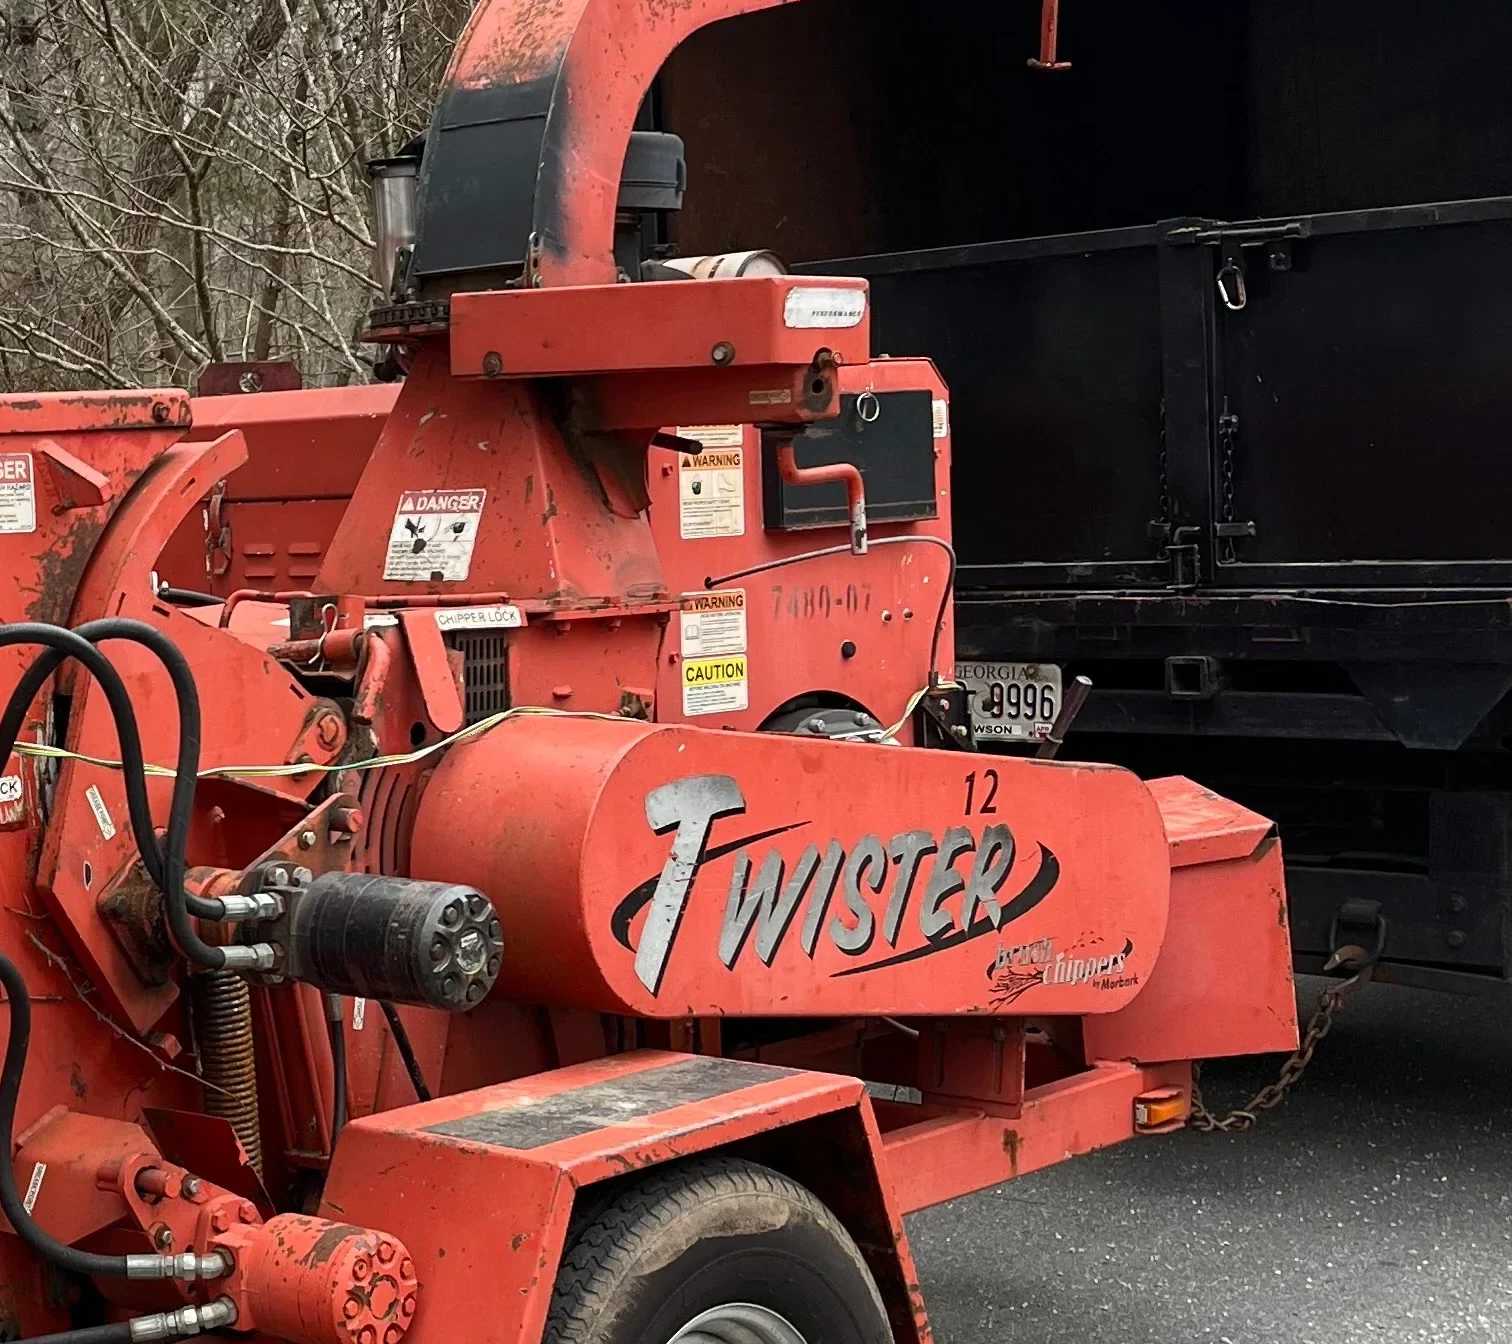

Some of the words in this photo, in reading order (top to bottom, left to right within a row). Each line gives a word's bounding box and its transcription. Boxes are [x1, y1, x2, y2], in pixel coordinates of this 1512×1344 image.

[692, 453, 741, 468] WARNING
[416, 495, 480, 512] DANGER
[694, 593, 744, 610] WARNING
[438, 612, 487, 625] CHIPPER
[488, 610, 518, 623] LOCK
[685, 661, 744, 682] CAUTION
[955, 664, 1028, 681] GEORGIA
[990, 682, 1054, 720] 9996
[973, 724, 1012, 734] WSON
[962, 768, 1000, 817] 12
[633, 772, 1018, 999] TWISTER
[1042, 951, 1127, 986] chippers
